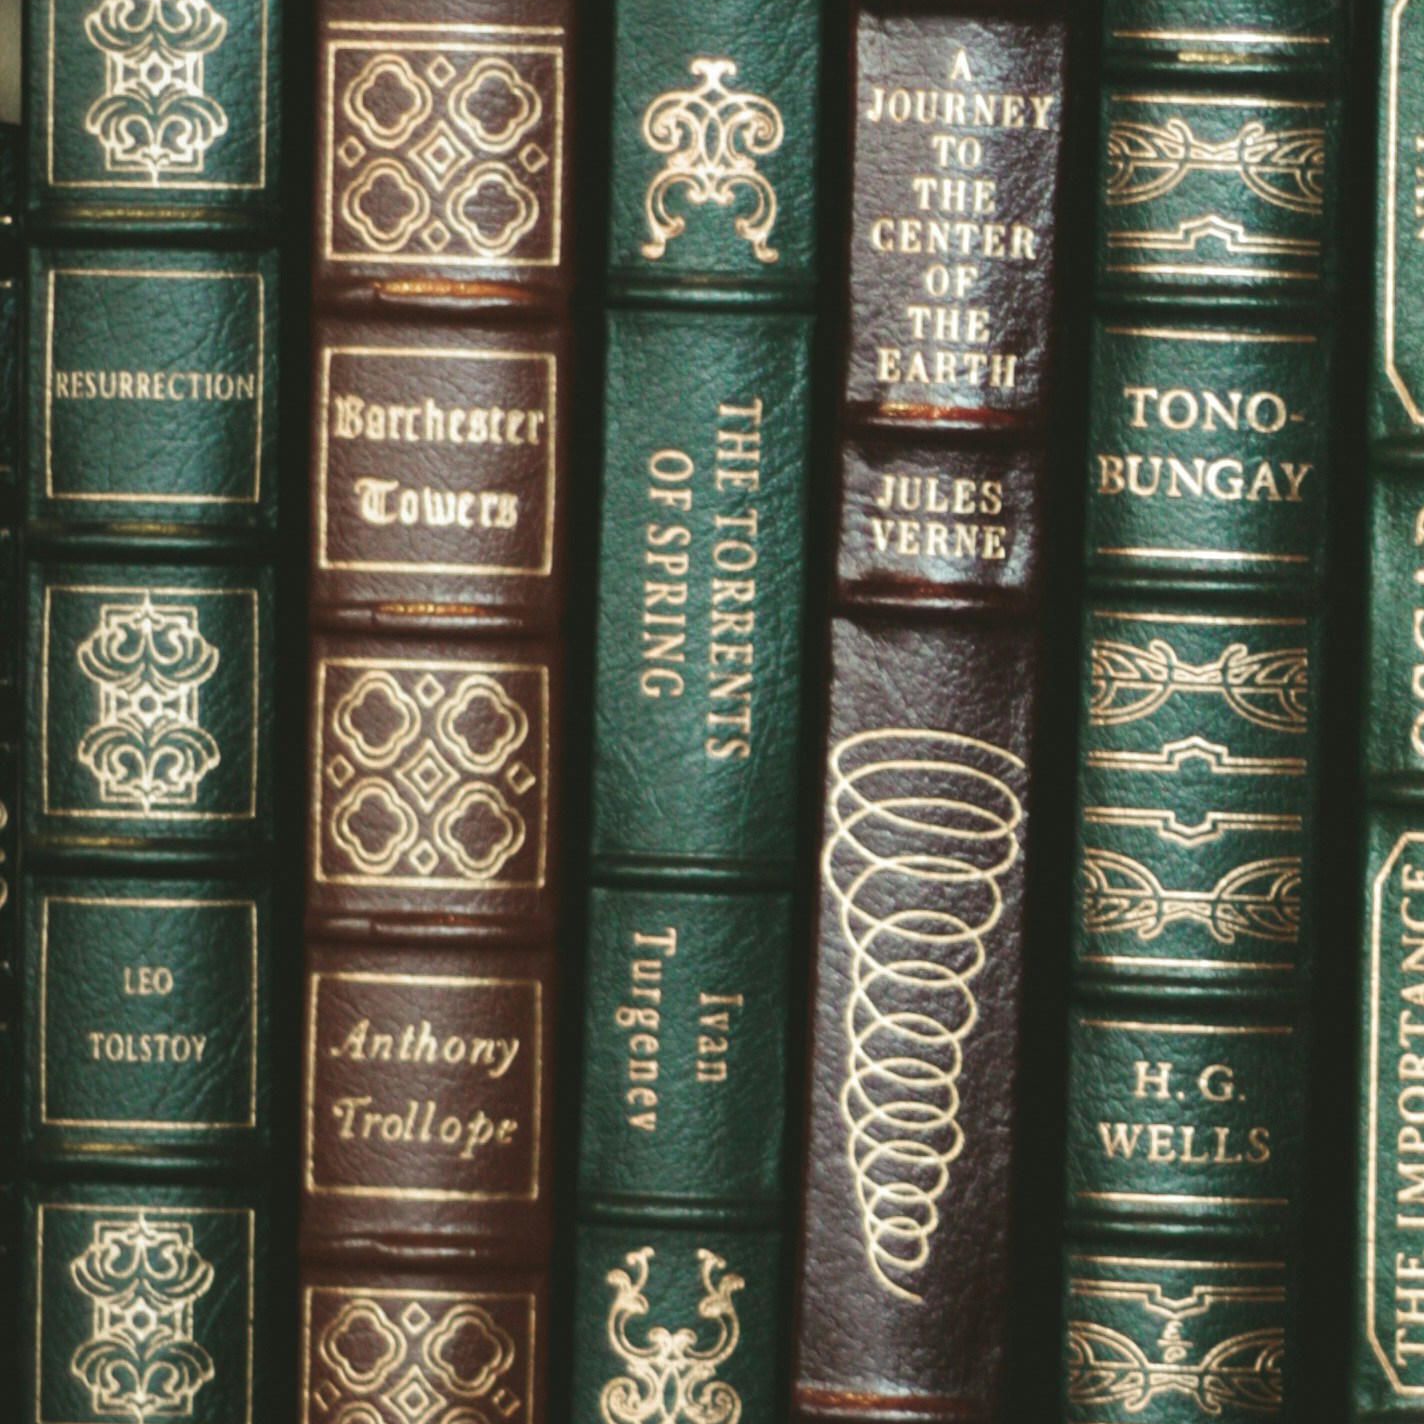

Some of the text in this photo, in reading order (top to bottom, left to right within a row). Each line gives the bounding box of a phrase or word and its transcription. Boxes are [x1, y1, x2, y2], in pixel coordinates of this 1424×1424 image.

[951, 49, 973, 82] A
[867, 88, 1054, 131] JOURNEY
[932, 135, 982, 170] TO
[914, 178, 997, 214] THE
[872, 220, 1038, 261] CENTER
[926, 264, 978, 299] OF
[907, 305, 991, 342] THE
[56, 372, 255, 401] RESURRECTION
[877, 347, 1018, 388] EARTH
[335, 398, 545, 446] Barchester
[1124, 387, 1304, 434] TONO-
[876, 475, 1003, 515] JULES
[1098, 457, 1313, 502] BUNGAY
[353, 477, 518, 528] Towers
[872, 521, 1007, 561] VERNE
[640, 449, 695, 699] OF SPRING
[706, 399, 763, 760] THE TORRENTS
[124, 968, 173, 995] LEO
[89, 1032, 207, 1063] TOLSTOY
[331, 1020, 520, 1078] Anthony
[616, 928, 677, 1132] Turgenev
[696, 993, 743, 1083] Ivan
[1134, 1061, 1246, 1102] H. G.
[332, 1098, 518, 1160] Trollope
[1098, 1122, 1271, 1163] WELLS
